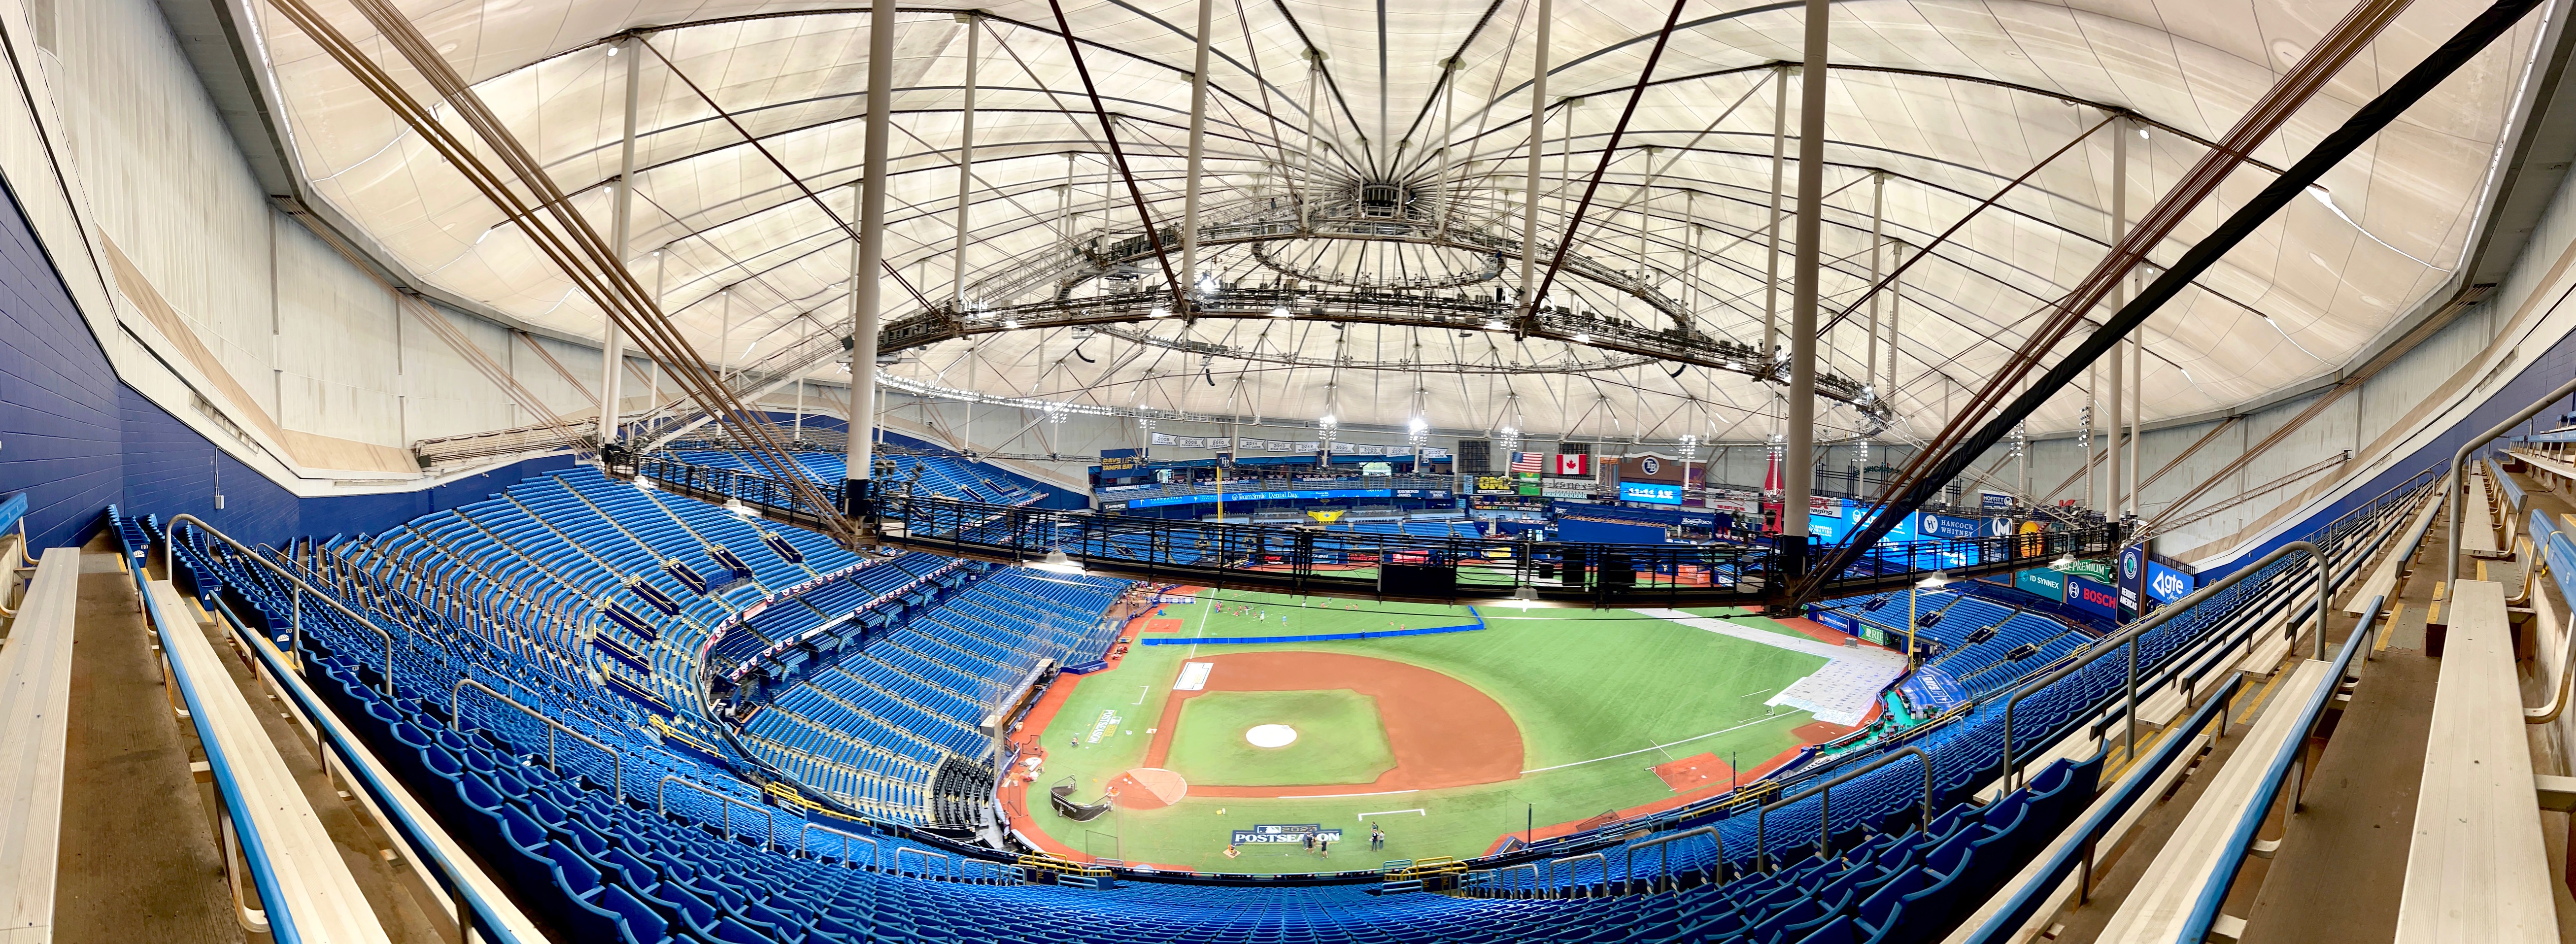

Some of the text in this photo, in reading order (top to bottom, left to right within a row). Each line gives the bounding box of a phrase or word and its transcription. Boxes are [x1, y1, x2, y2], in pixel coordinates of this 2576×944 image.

[1220, 457, 1229, 467] TB
[1646, 460, 1657, 472] TB
[1941, 519, 1973, 530] HANCOCK
[1941, 527, 1973, 537] WHITNEY
[2071, 561, 2104, 575] PREMIUM
[2037, 577, 2059, 589] SYNNEX
[2165, 574, 2184, 594] gte
[2083, 588, 2116, 609] BOSCH
[2120, 595, 2137, 611] AMERICAS
[1004, 686, 1026, 704] TROPICANA
[1087, 709, 1116, 743] POSTSEASON
[1235, 833, 1340, 843] POSTSEAON
